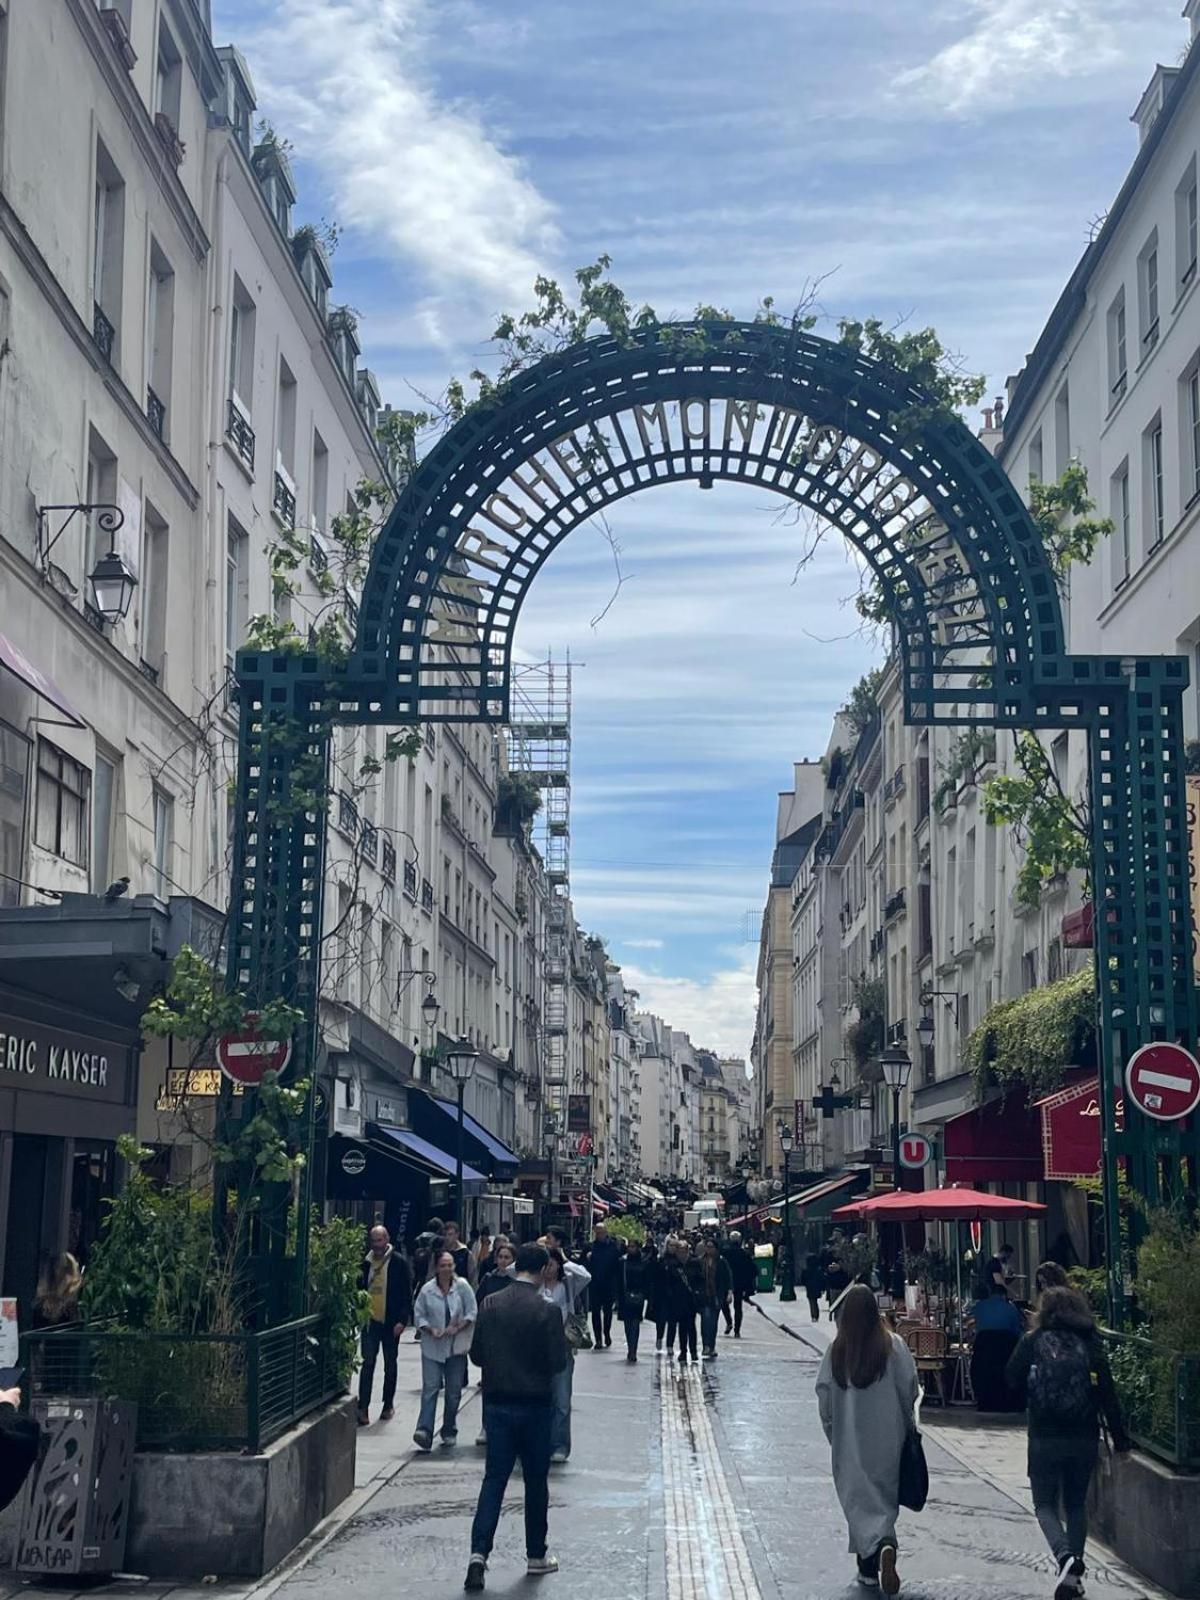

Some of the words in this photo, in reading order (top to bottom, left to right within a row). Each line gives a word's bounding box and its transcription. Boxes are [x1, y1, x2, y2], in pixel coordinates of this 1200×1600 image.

[632, 398, 986, 645] MONTORGUEIL
[0, 1033, 37, 1074] ERIC
[48, 1045, 108, 1087] KAYSER
[904, 1142, 924, 1162] U
